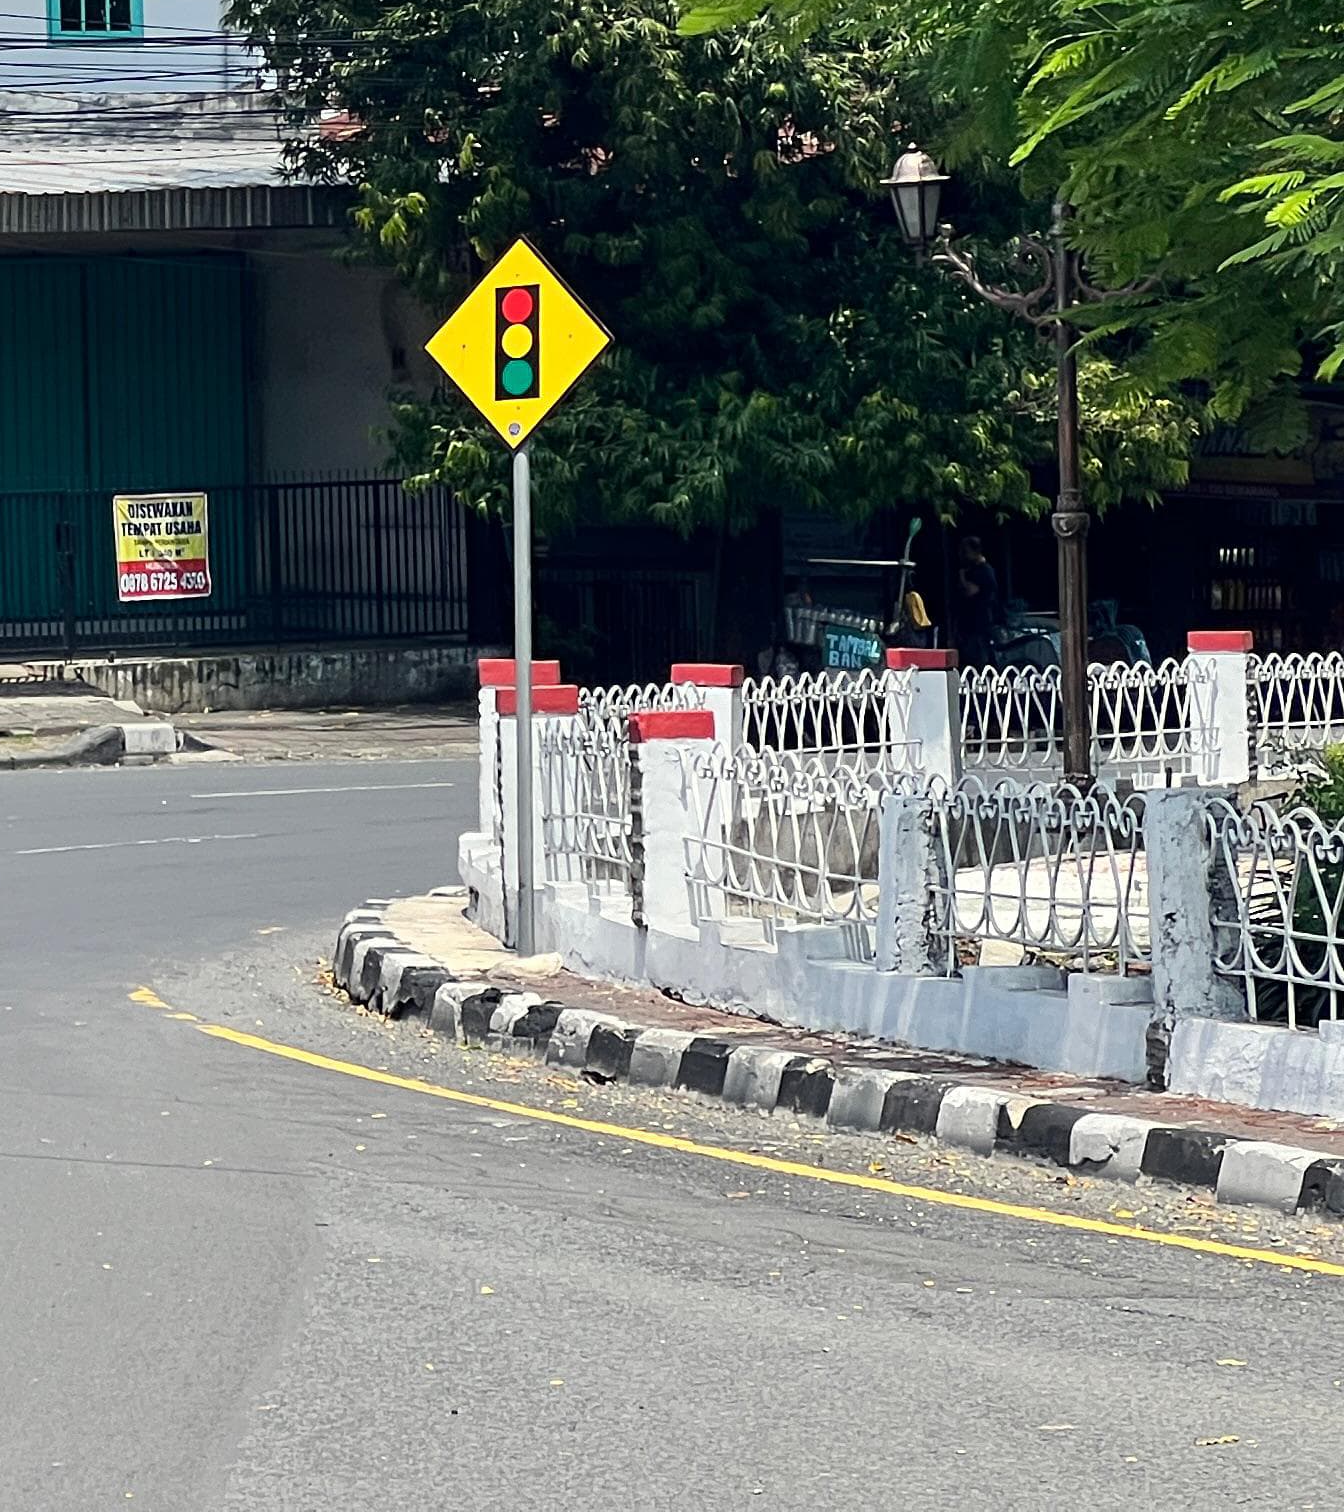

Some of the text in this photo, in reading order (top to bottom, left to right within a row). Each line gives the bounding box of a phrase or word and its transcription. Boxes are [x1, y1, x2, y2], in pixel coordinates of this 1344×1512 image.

[128, 502, 192, 519] DISEWAKAN
[122, 520, 202, 536] TEMPAT USAHA
[826, 634, 880, 658] TAMBAL
[829, 651, 862, 668] BAN
